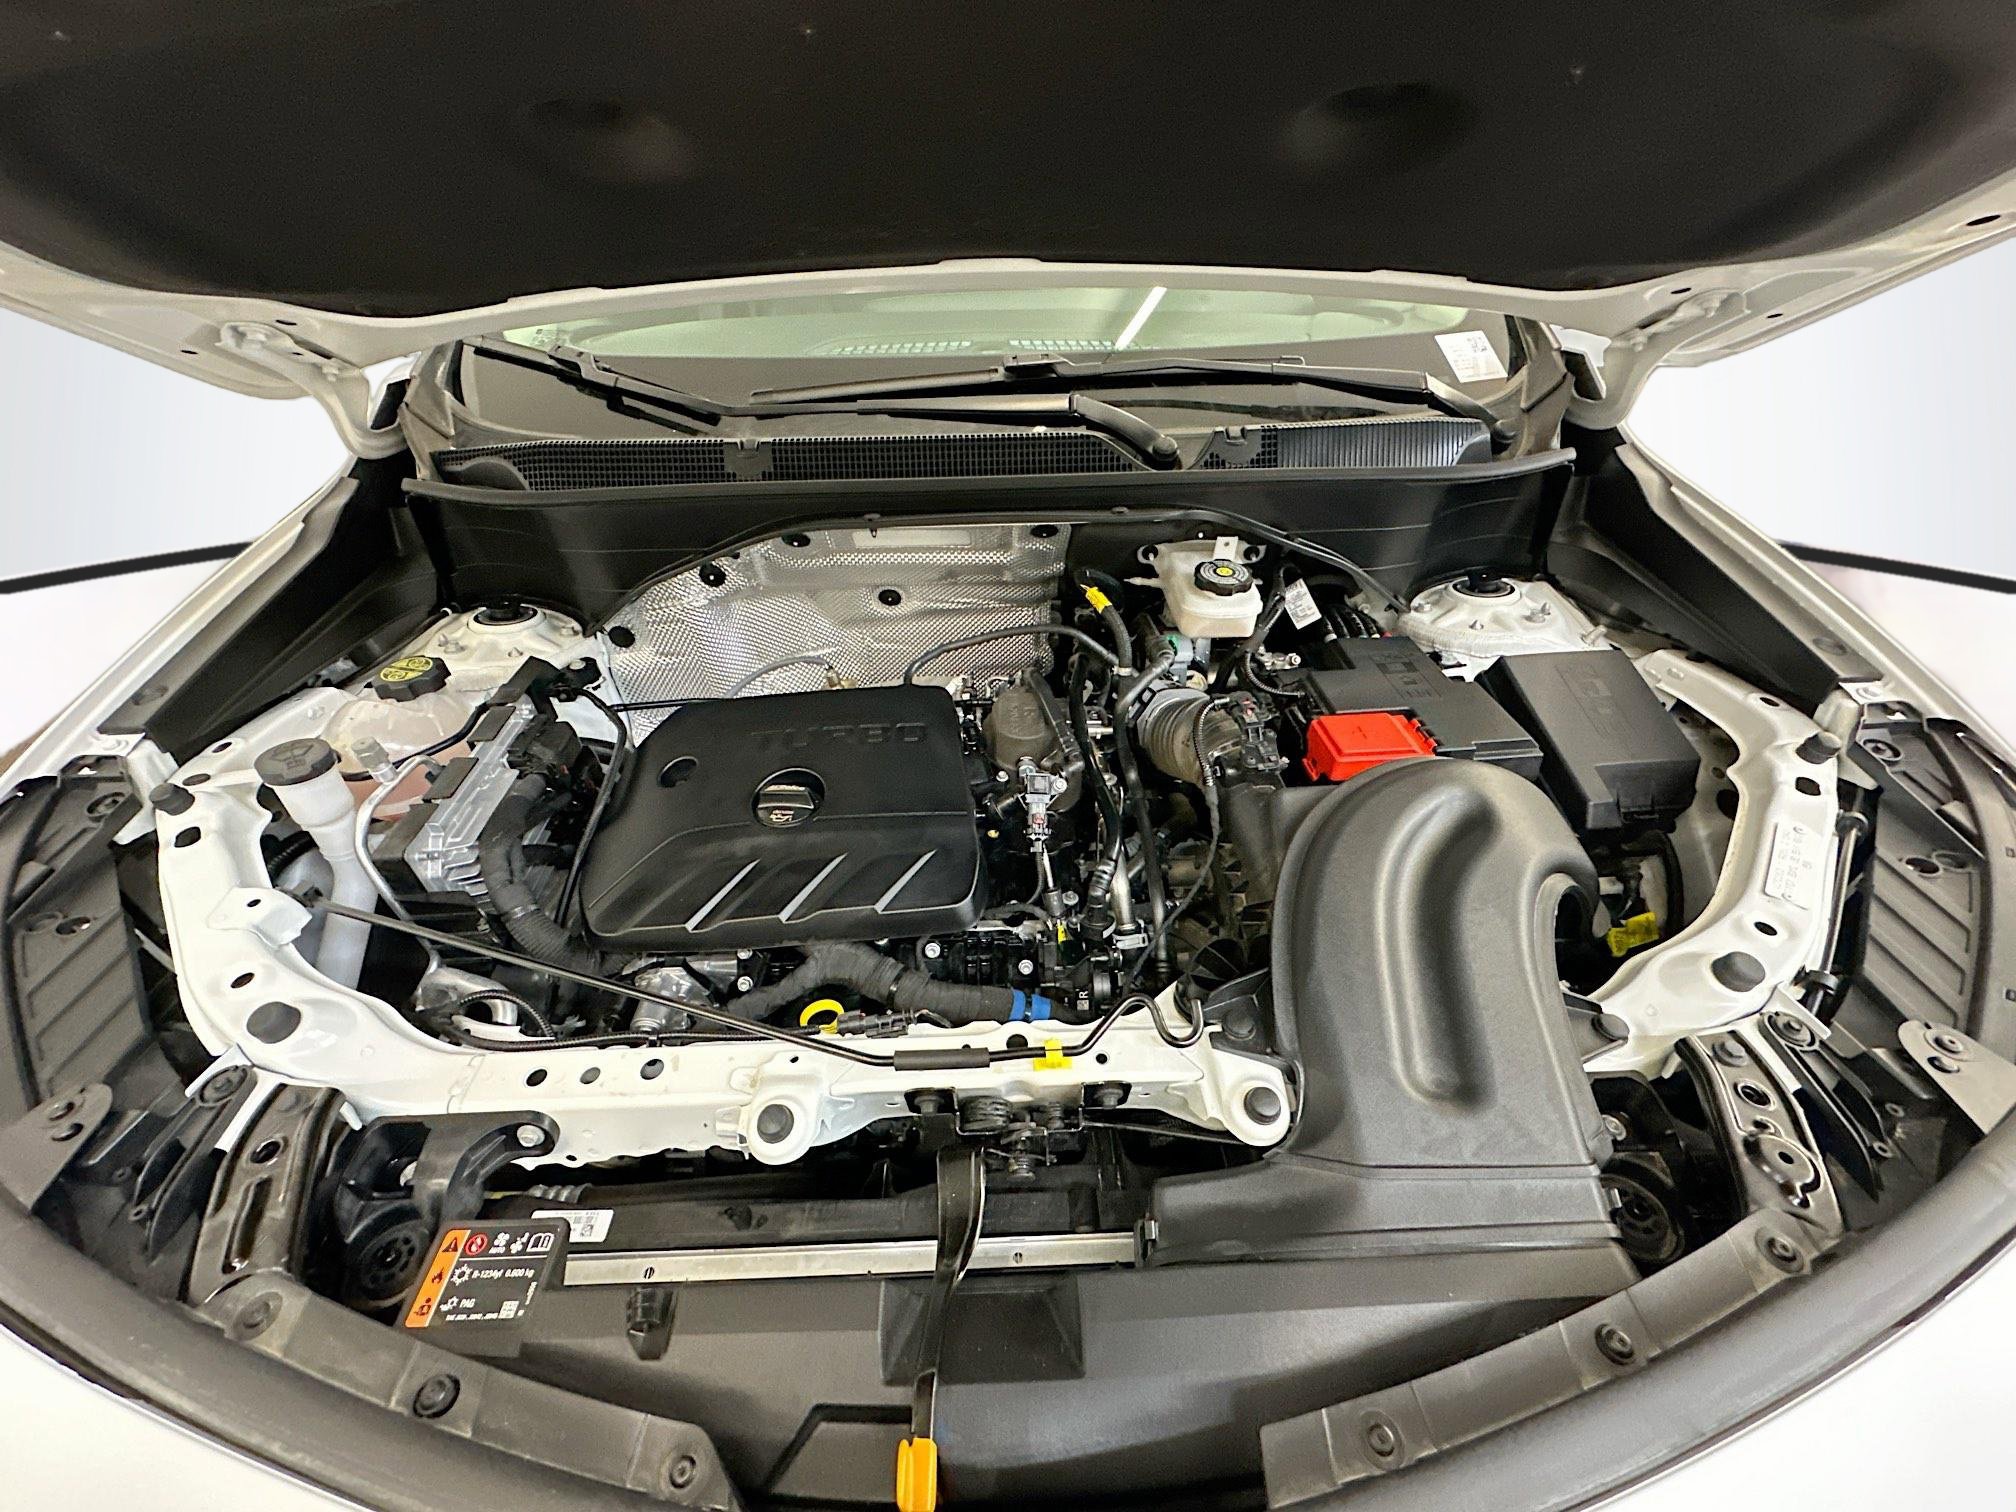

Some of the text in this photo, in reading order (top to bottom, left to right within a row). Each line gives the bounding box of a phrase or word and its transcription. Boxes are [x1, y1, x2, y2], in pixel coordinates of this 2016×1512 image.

[750, 722, 927, 749] TURBO
[525, 1268, 535, 1278] kg
[460, 1298, 476, 1309] PAG
